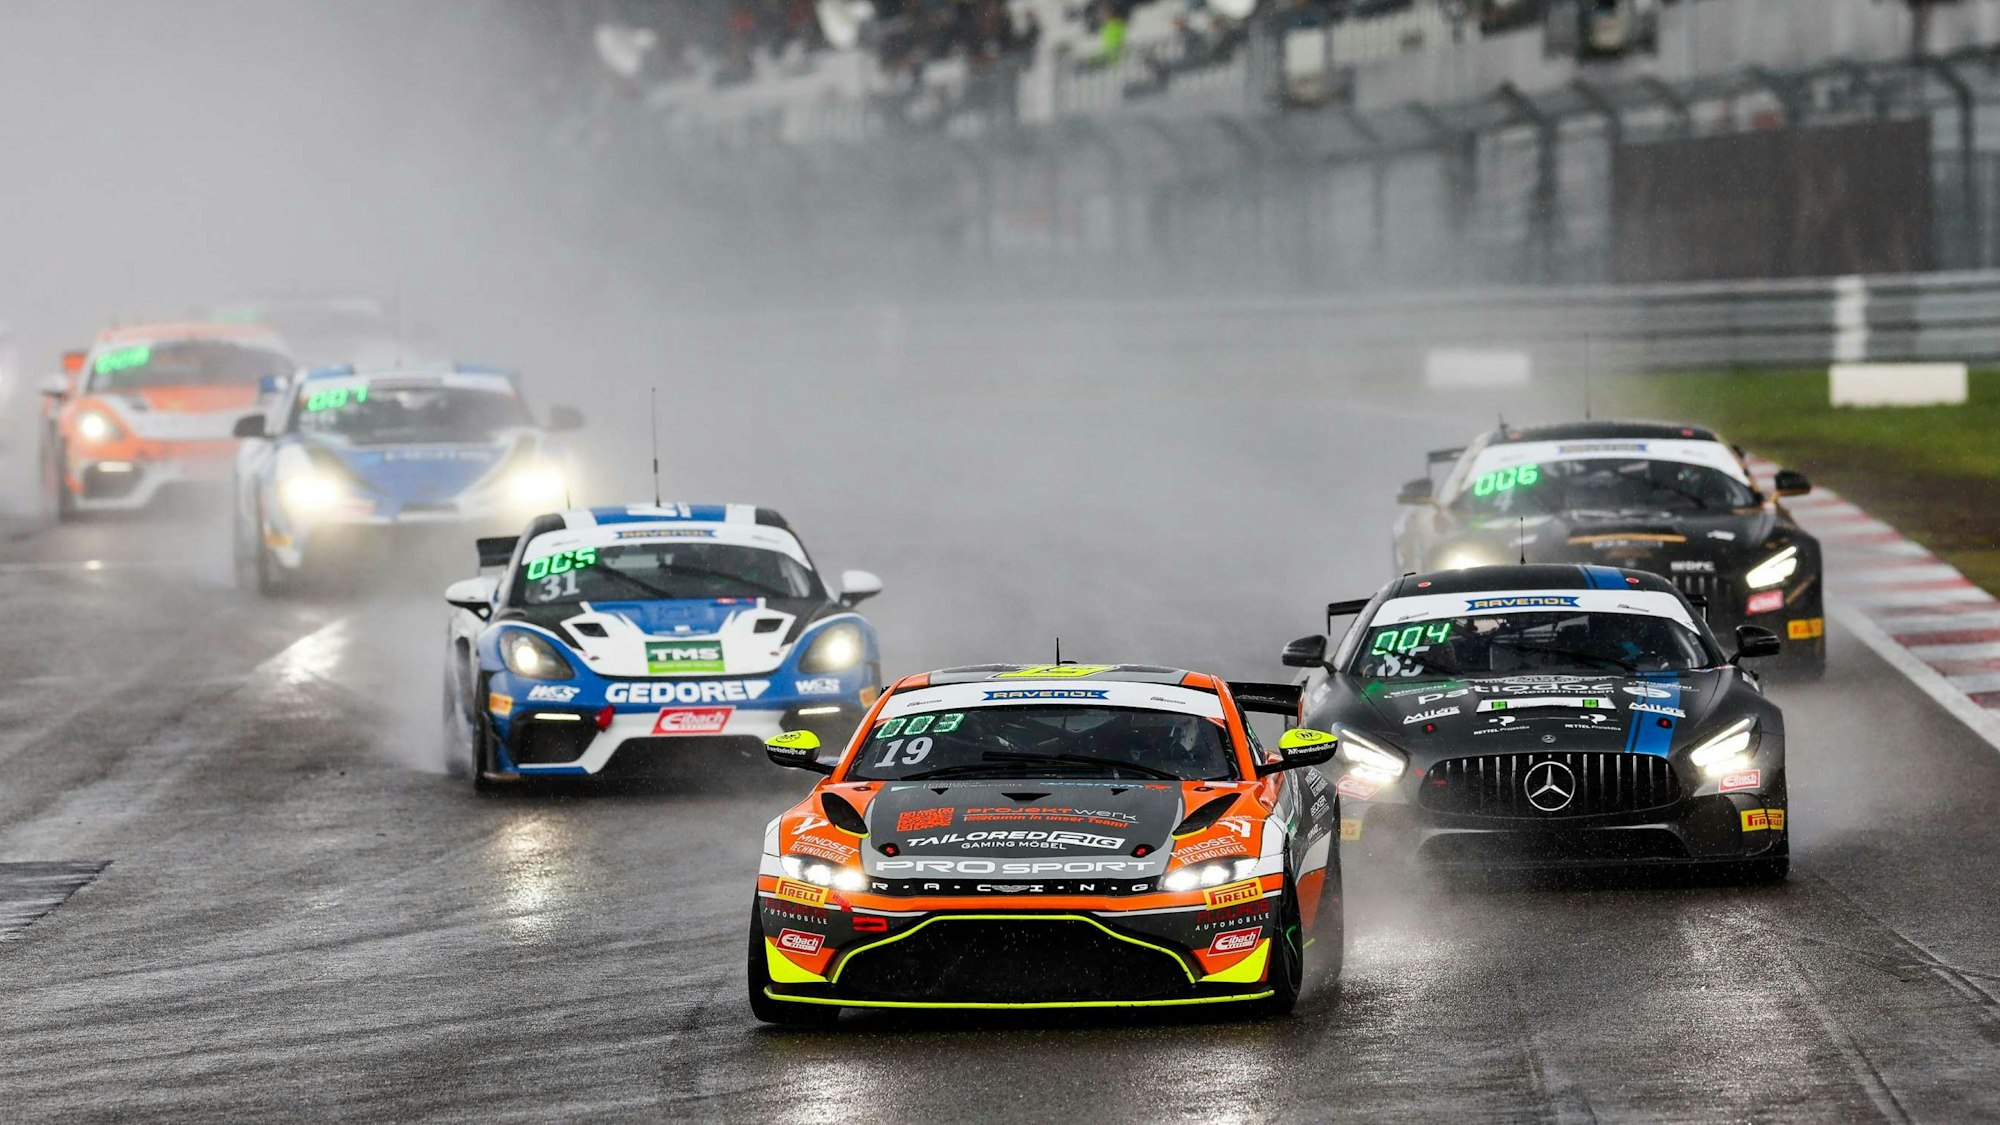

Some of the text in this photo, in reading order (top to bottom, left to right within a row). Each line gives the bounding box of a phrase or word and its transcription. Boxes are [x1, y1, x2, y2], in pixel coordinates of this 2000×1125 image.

[1474, 464, 1538, 496] 006
[538, 571, 580, 601] 31
[1474, 598, 1571, 608] RAVENOL
[1372, 622, 1451, 656] 004
[650, 647, 720, 661] TMS
[605, 681, 745, 704] GEDORE
[993, 690, 1099, 700] RAVENOL
[875, 712, 963, 739] 003
[874, 737, 934, 768] 19
[1746, 813, 1783, 827] PIRELLI
[799, 833, 860, 855] MINDSET
[906, 831, 1048, 847] TAILORED
[961, 840, 1067, 850] GAMING MÖBEL
[1171, 835, 1237, 858] MINDSET
[790, 841, 850, 865] TECHNOLOGIES
[1177, 844, 1248, 866] TECHNOLOGIES
[780, 881, 822, 903] PIRELLI
[1209, 882, 1258, 906] PIRELLI
[764, 907, 828, 926] AUTOMOBILE
[1195, 912, 1270, 932] AUTOMOBILE
[781, 933, 819, 951] Eibach
[1215, 931, 1257, 951] Eibach
